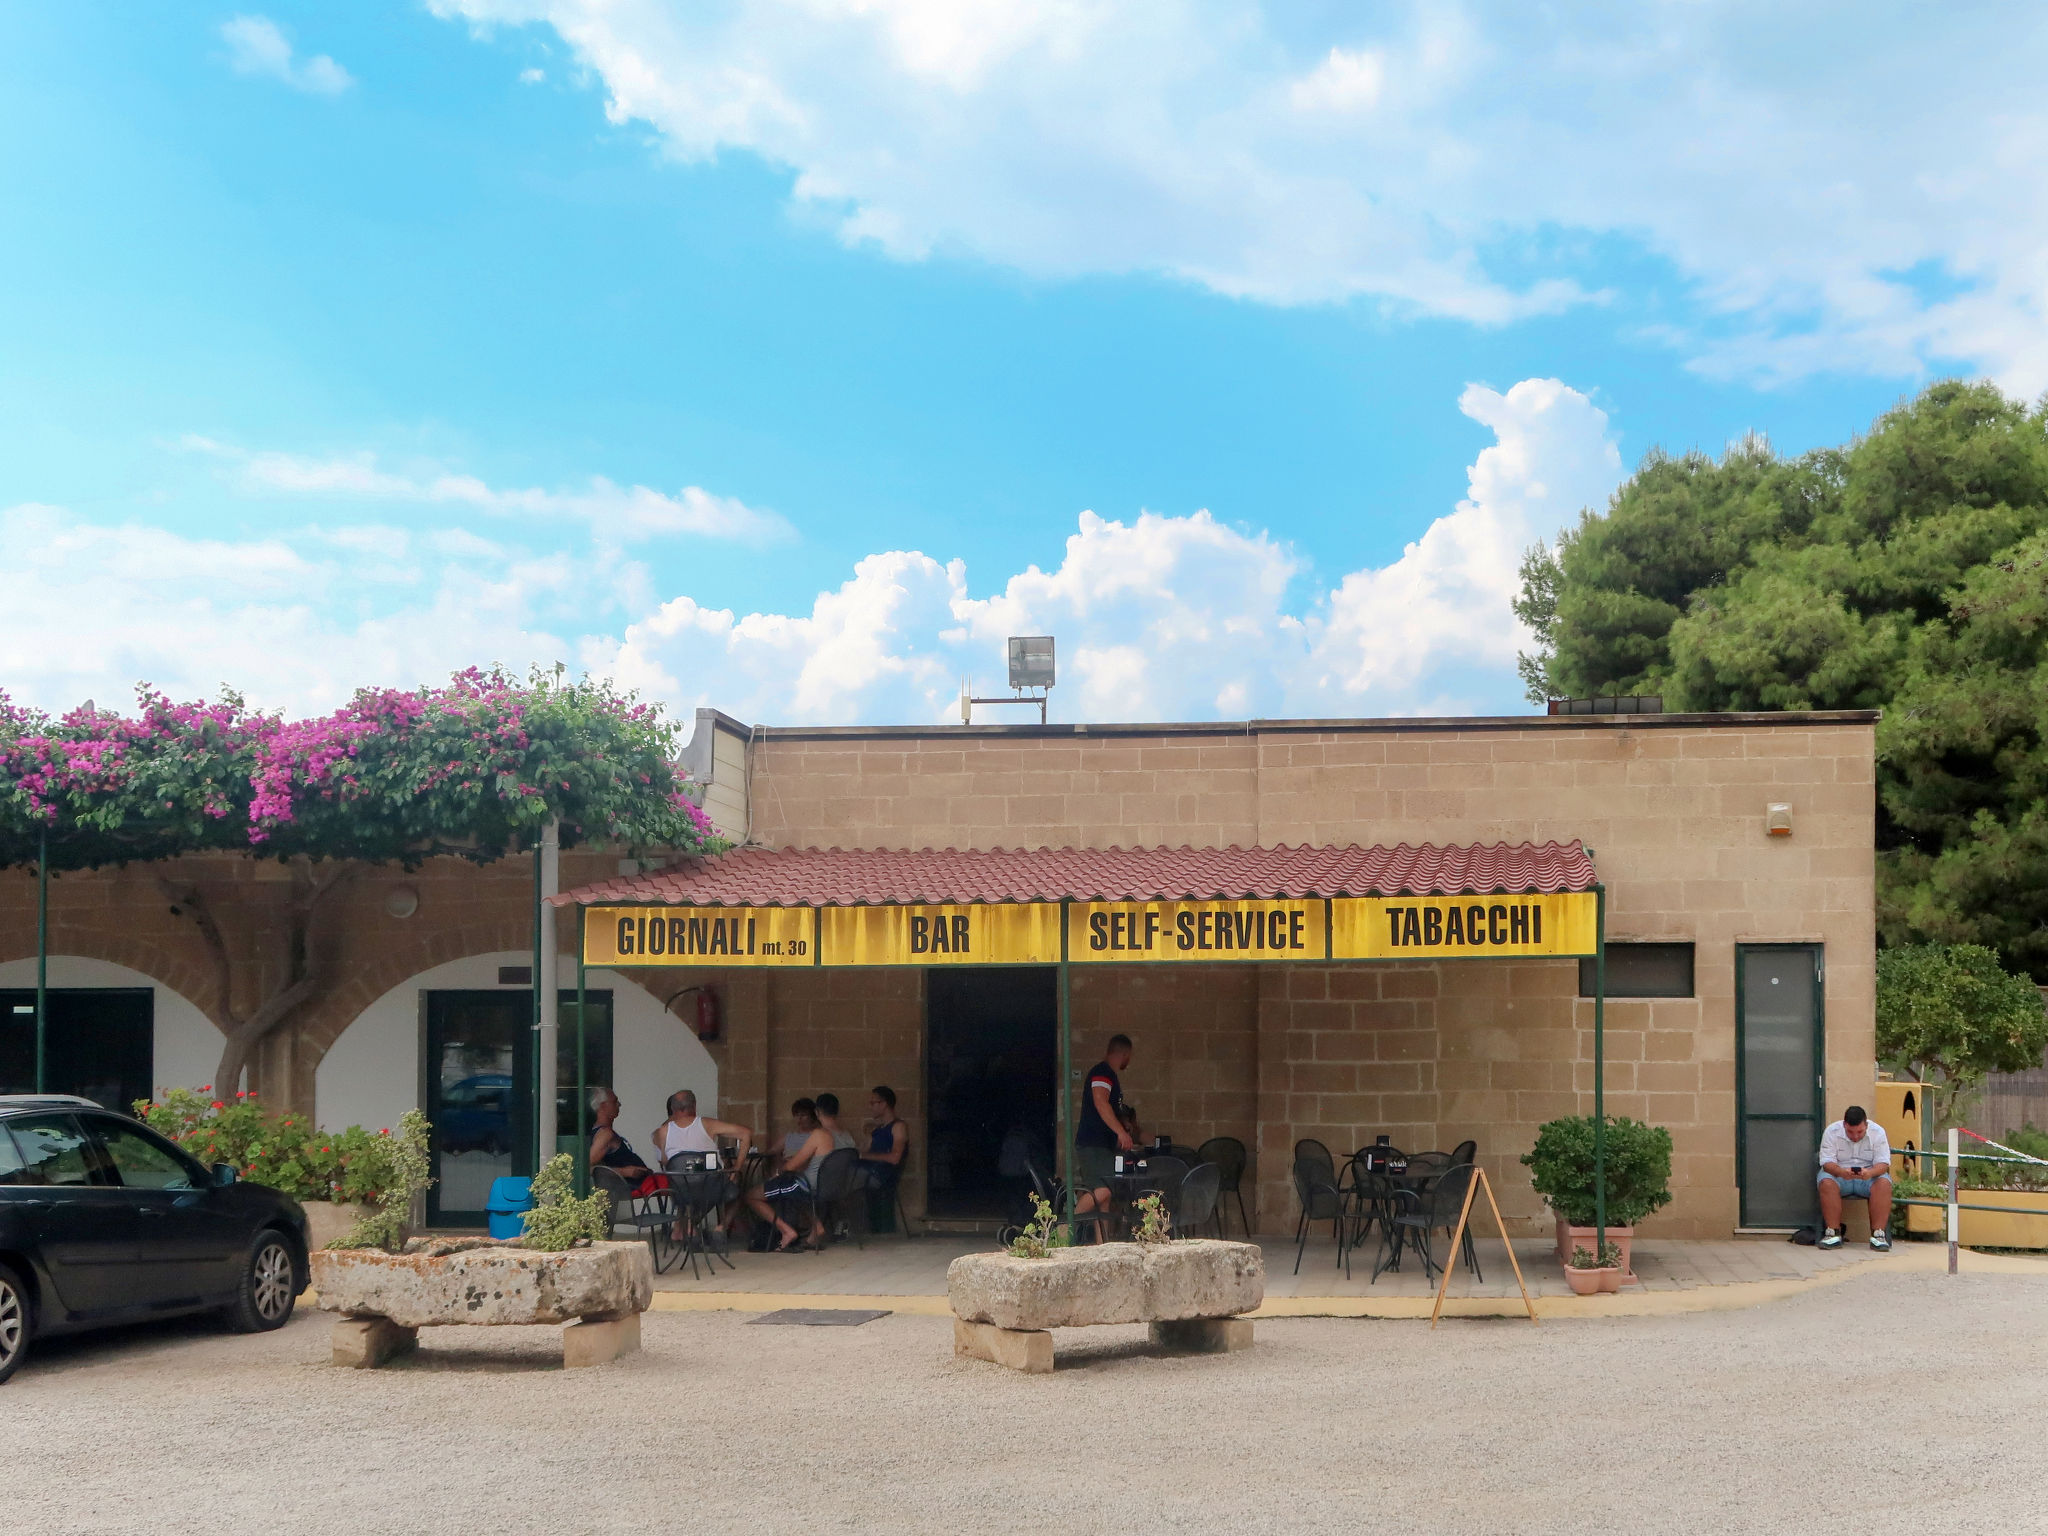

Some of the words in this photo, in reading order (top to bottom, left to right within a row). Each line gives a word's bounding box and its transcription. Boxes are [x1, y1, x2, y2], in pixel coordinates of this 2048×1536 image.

[617, 916, 756, 956] GIORNALI
[761, 941, 785, 956] mt.
[788, 940, 807, 956] 30
[910, 915, 970, 954] BAR
[1089, 910, 1305, 951] SELF-SERVICE
[1385, 904, 1542, 947] TABACCHI
